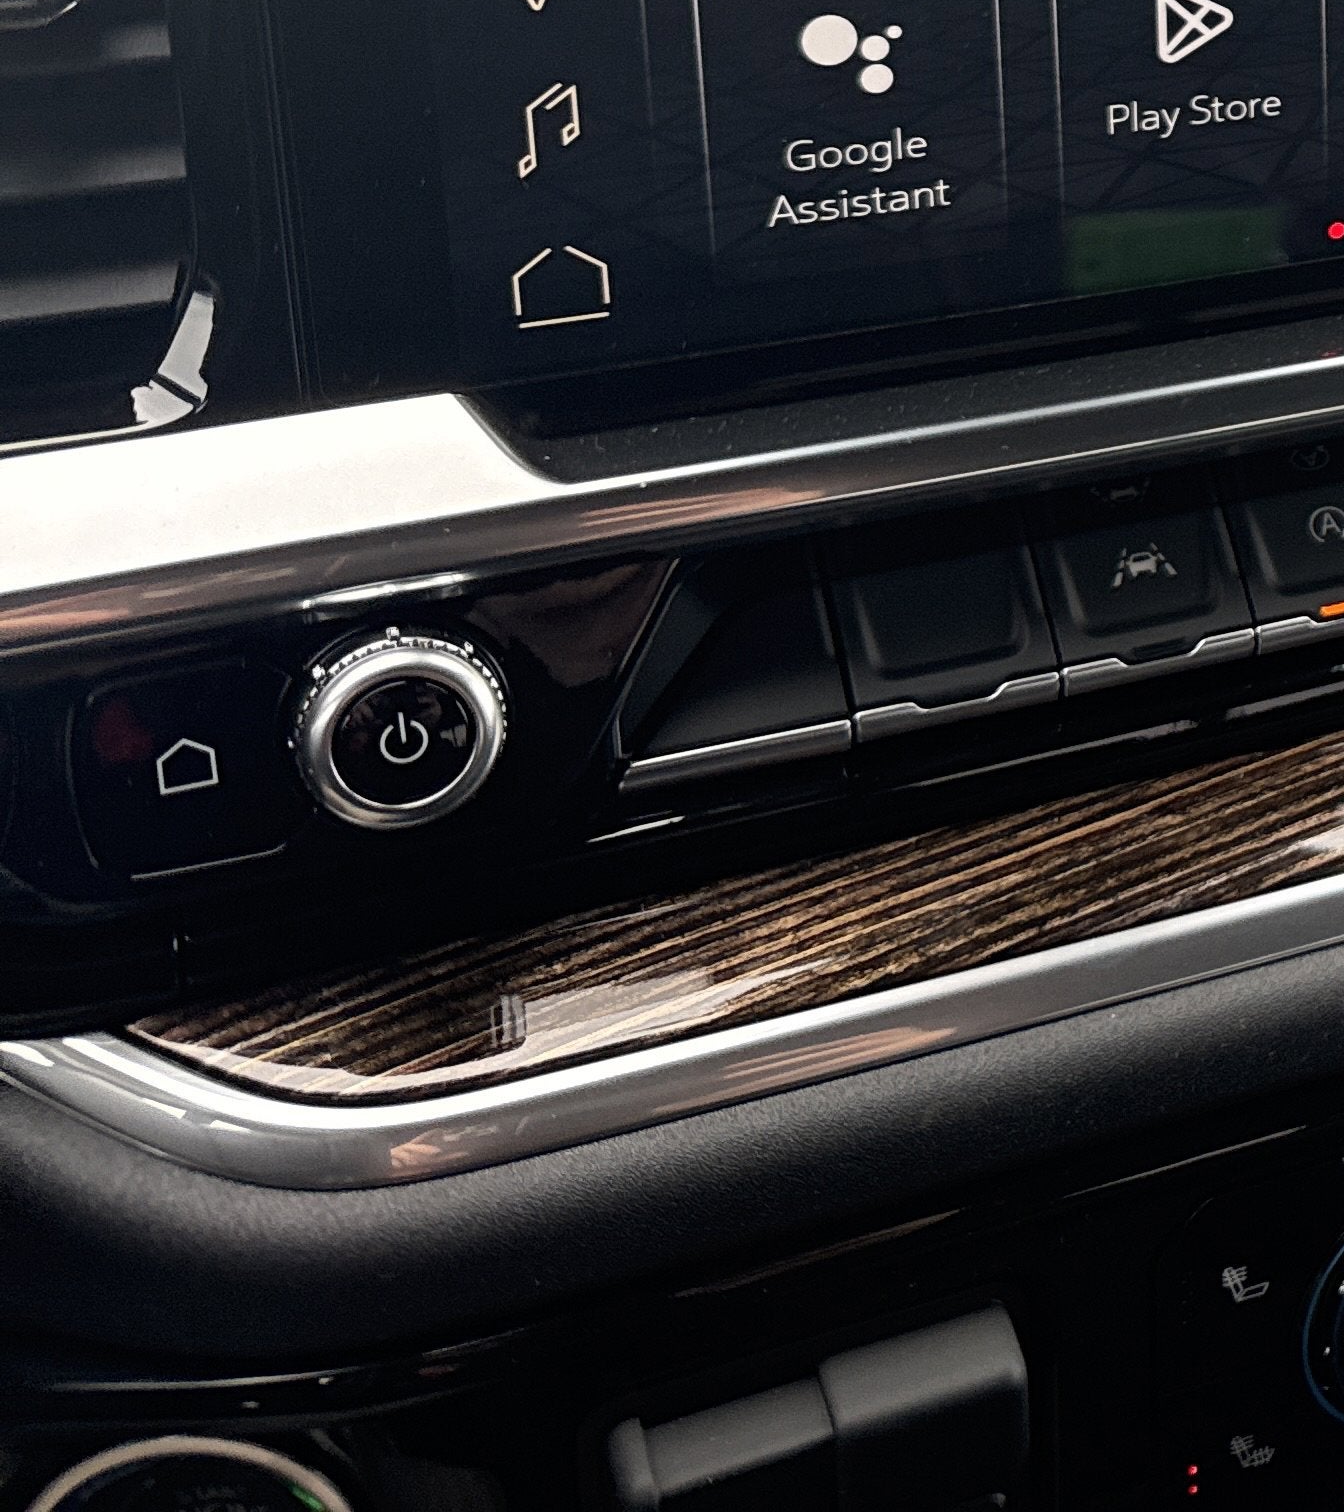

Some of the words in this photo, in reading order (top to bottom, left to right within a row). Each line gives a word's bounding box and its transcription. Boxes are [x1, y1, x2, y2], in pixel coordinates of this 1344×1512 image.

[1106, 99, 1181, 140] Play
[1189, 91, 1283, 126] Store
[785, 126, 929, 174] Google
[767, 178, 952, 228] Assistant
